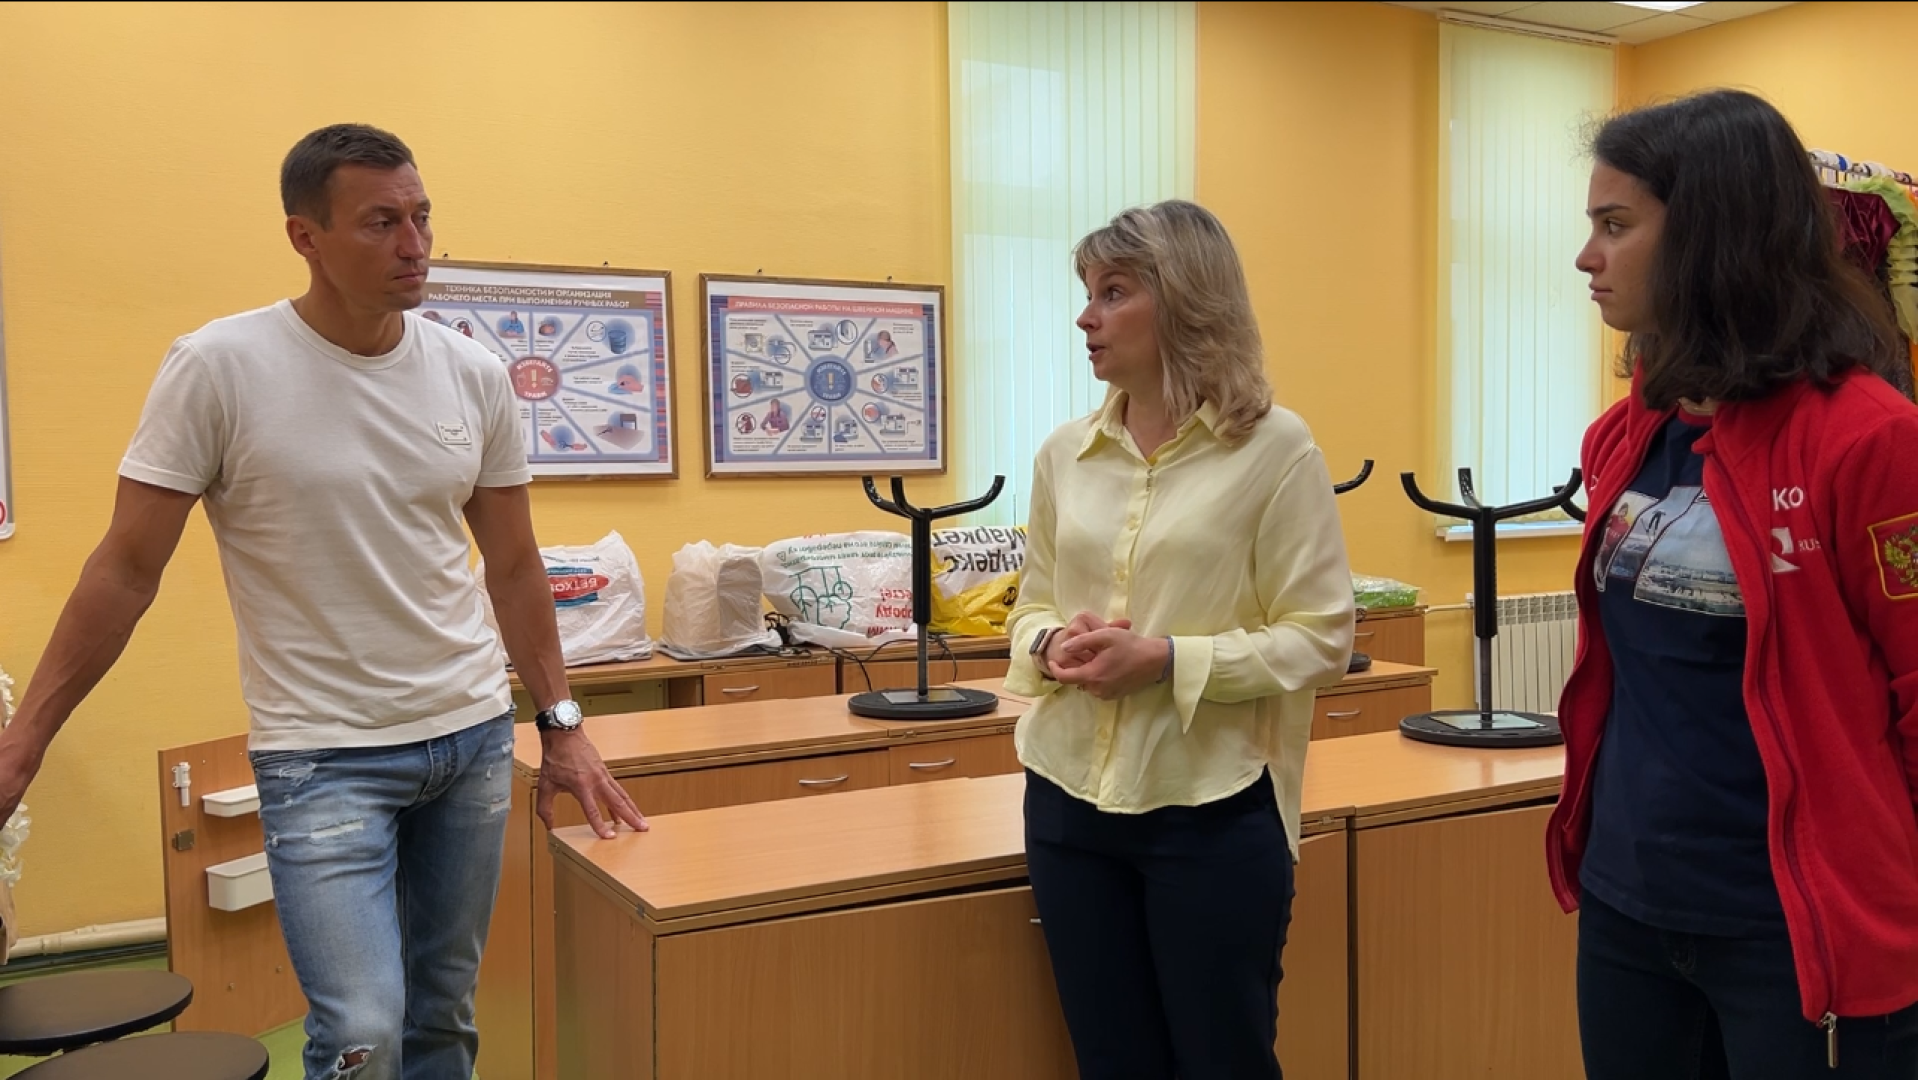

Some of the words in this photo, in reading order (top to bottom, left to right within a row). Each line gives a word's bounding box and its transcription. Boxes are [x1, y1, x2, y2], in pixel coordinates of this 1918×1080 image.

[445, 284, 482, 293] ТЕХНИКА
[484, 286, 547, 297] БЕЗОПАСНОСТИ
[556, 289, 611, 299] ОРГАНИЗАЦИЯ
[428, 293, 470, 302] РАБОЧЕГО
[472, 295, 498, 303] МЕСТА
[517, 297, 572, 306] ВЫПОЛНЕНИИ
[574, 299, 605, 307] РУЧНЫХ
[605, 300, 629, 308] РАБОТ
[735, 301, 766, 309] ПРАВИЛА
[768, 302, 814, 311] БЕЗОПАСНОЙ
[815, 304, 841, 312] РАБОТЫ
[852, 305, 885, 313] ШВЕЙНОЙ
[886, 307, 913, 315] МАШИНЕ
[932, 526, 1027, 550] Маркет
[875, 604, 912, 619] роду
